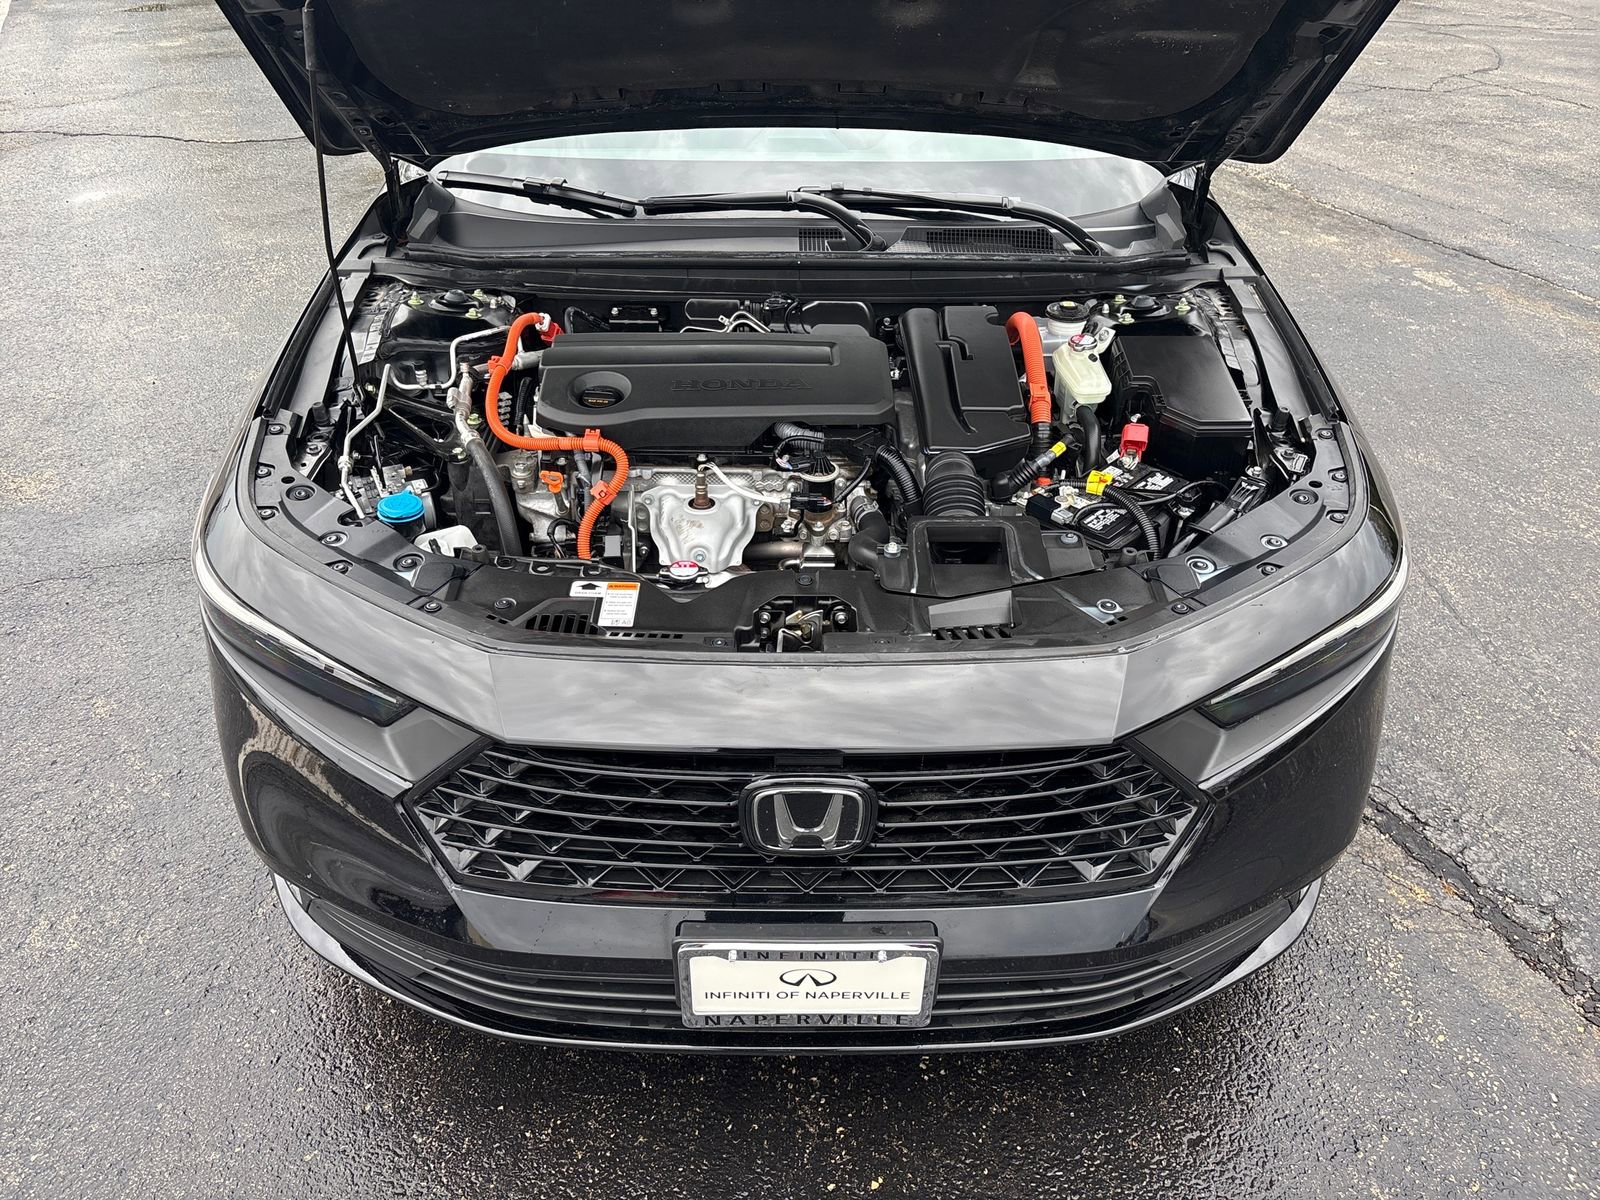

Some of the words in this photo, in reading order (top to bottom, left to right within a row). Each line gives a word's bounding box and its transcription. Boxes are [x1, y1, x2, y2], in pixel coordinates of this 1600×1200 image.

[671, 377, 813, 391] HONDA
[743, 951, 875, 960] INFINITI
[704, 991, 770, 1000] INFINITI
[776, 991, 799, 1000] OF
[805, 991, 911, 1000] NAPERVILLE
[704, 1014, 909, 1026] NAPERVILLE
